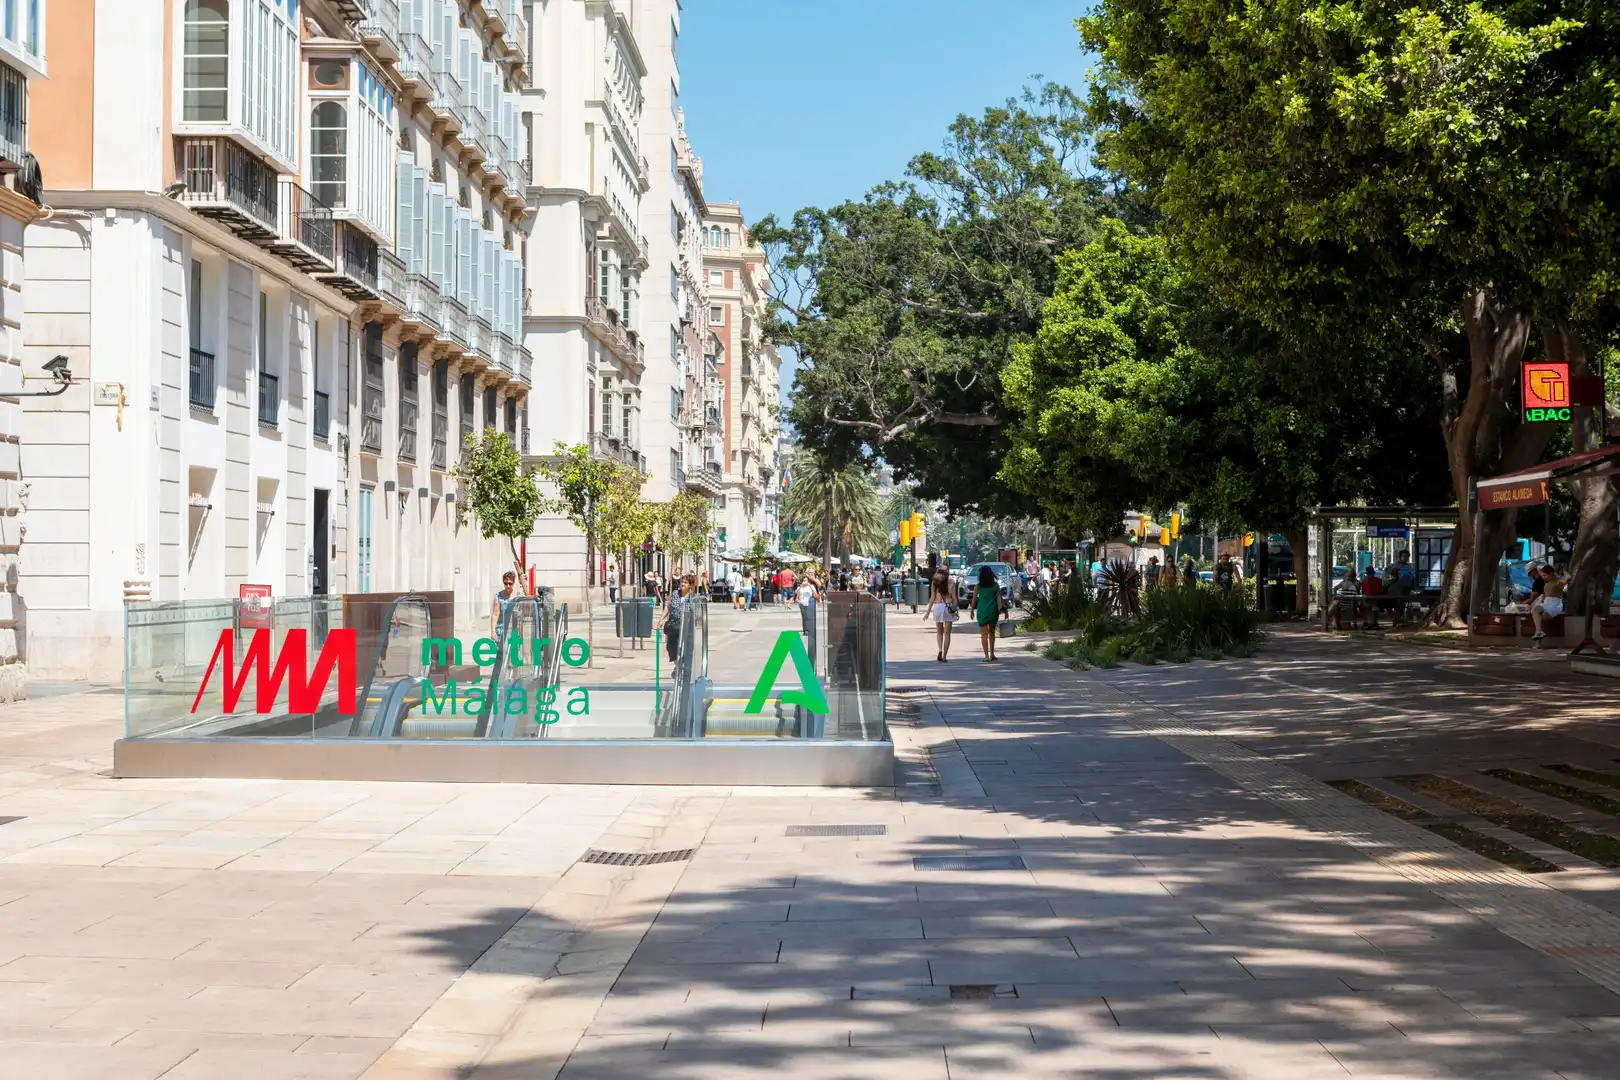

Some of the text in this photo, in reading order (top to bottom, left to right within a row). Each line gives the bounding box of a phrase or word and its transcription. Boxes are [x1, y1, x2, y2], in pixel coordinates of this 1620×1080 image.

[1512, 487, 1533, 501] ALAMEDA
[421, 628, 591, 667] metro
[421, 676, 590, 725] Málaga
